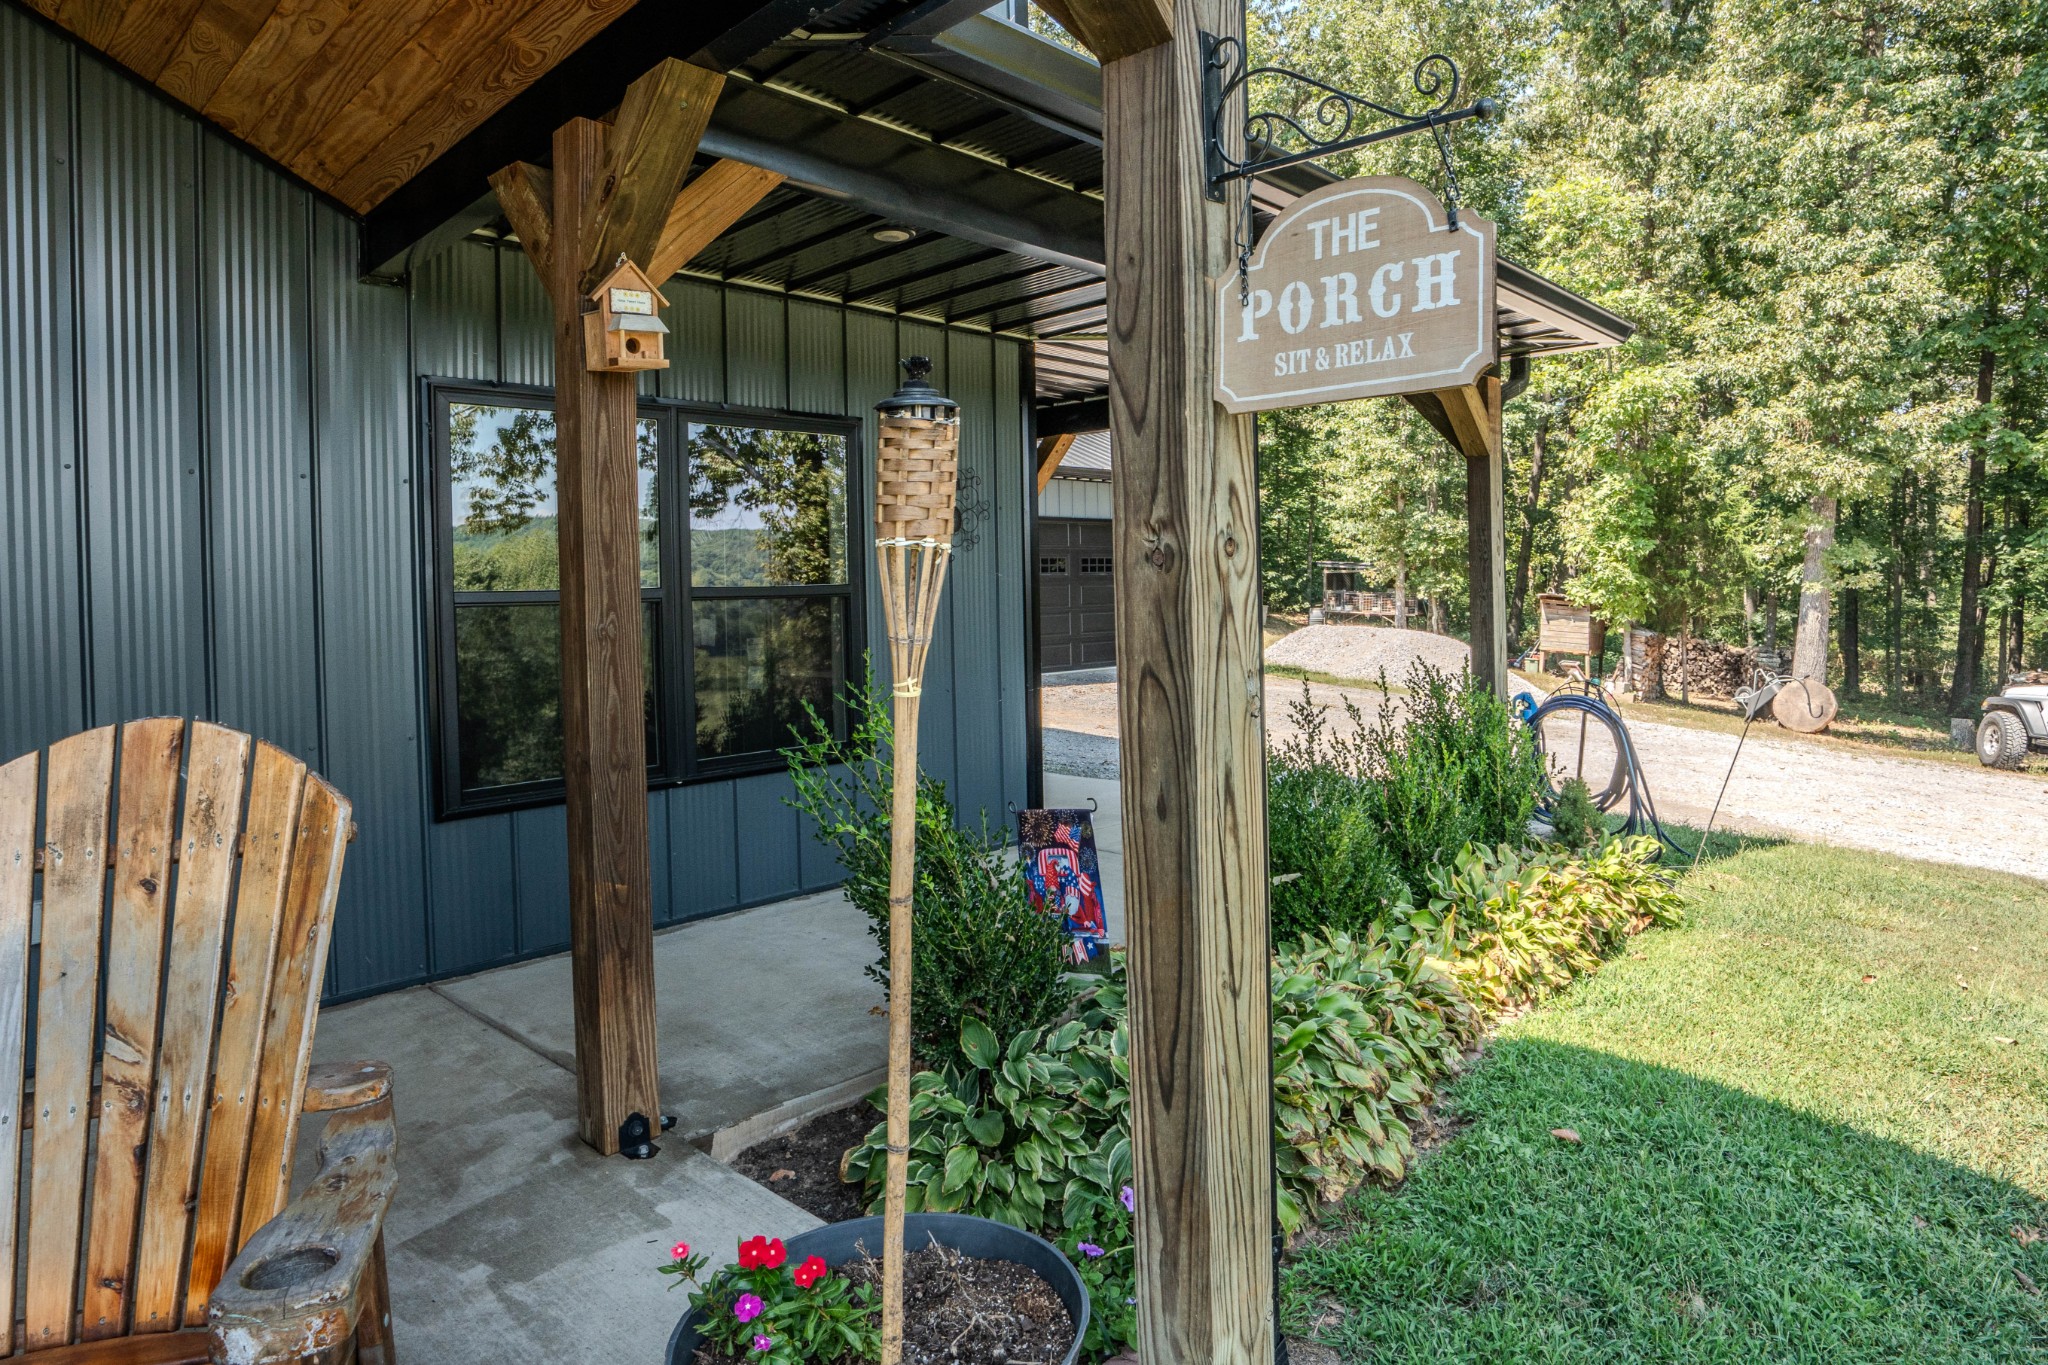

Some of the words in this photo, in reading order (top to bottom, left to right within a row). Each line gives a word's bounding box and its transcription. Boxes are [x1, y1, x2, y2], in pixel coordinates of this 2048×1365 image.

[1307, 207, 1380, 260] THE
[1237, 250, 1461, 343] PORCH
[1274, 348, 1311, 377] SIT
[1314, 346, 1330, 371] &
[1334, 332, 1416, 368] RELAX
